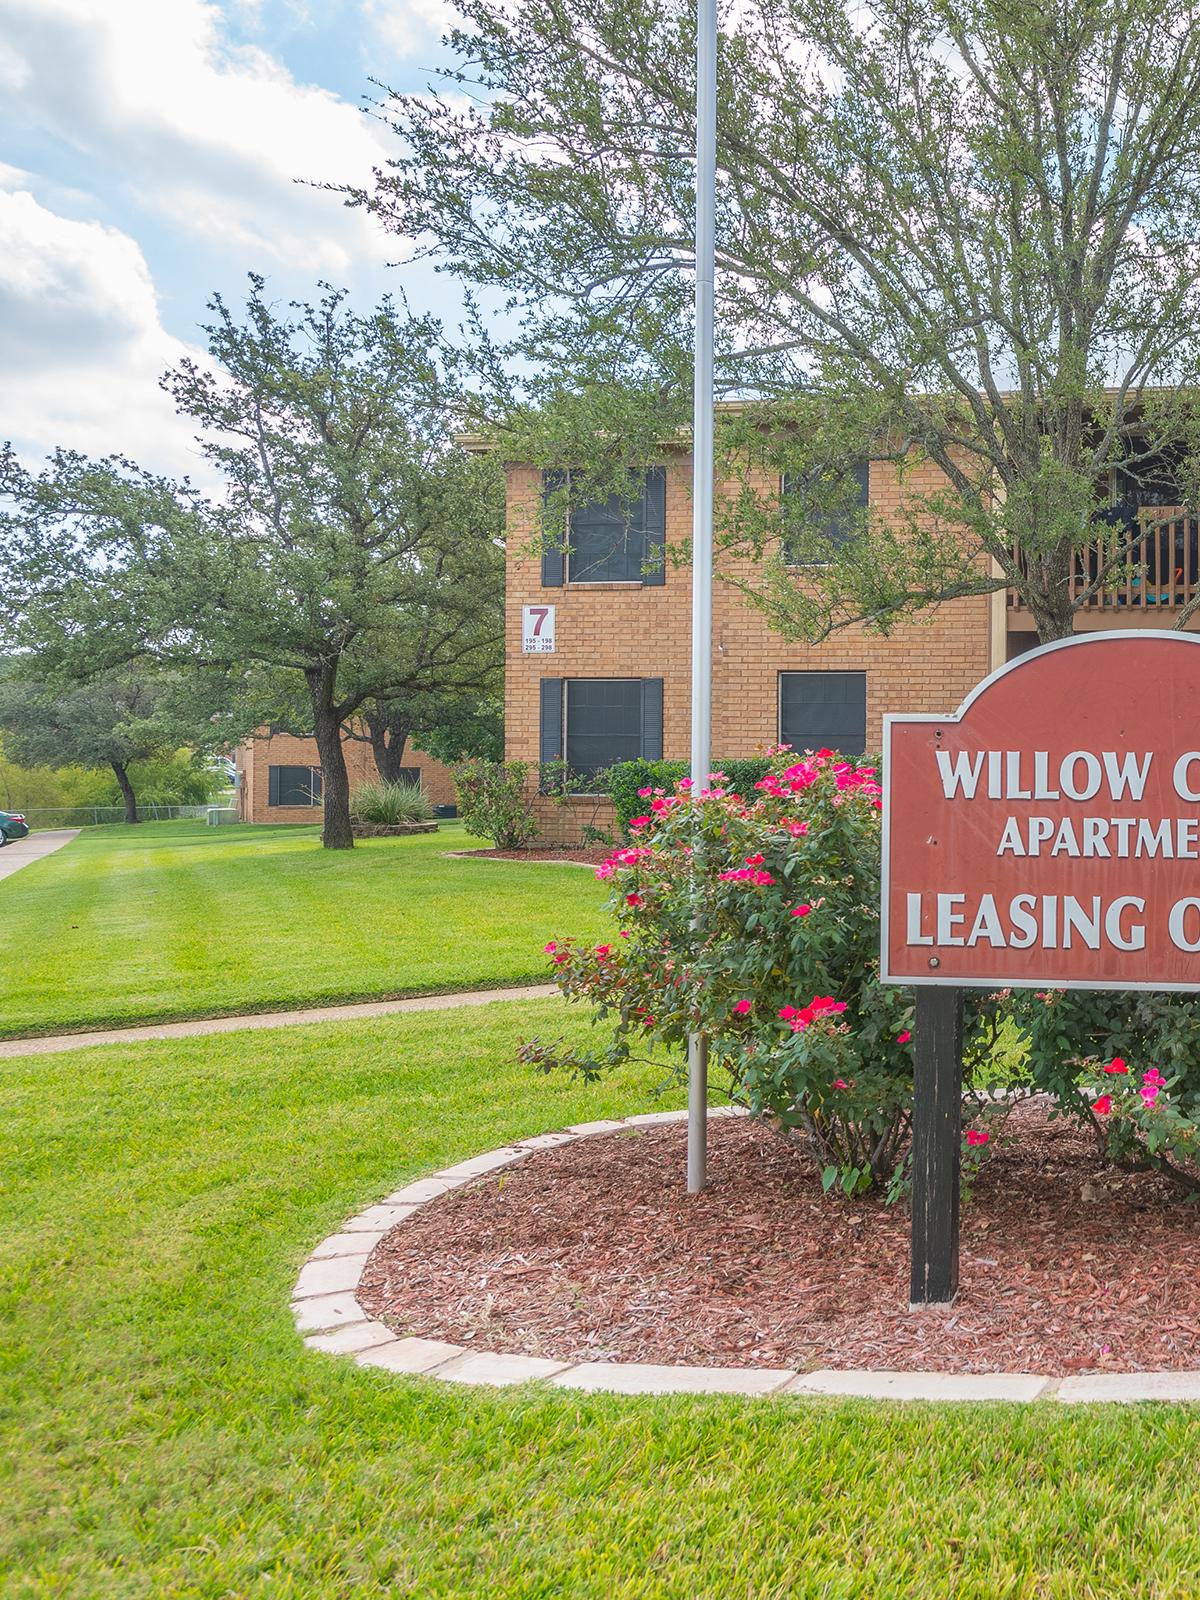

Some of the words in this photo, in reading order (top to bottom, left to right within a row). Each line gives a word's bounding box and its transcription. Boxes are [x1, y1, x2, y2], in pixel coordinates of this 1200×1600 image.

[529, 608, 549, 636] 7
[934, 750, 1154, 801] WILLOW
[906, 892, 1146, 951] LEASING
